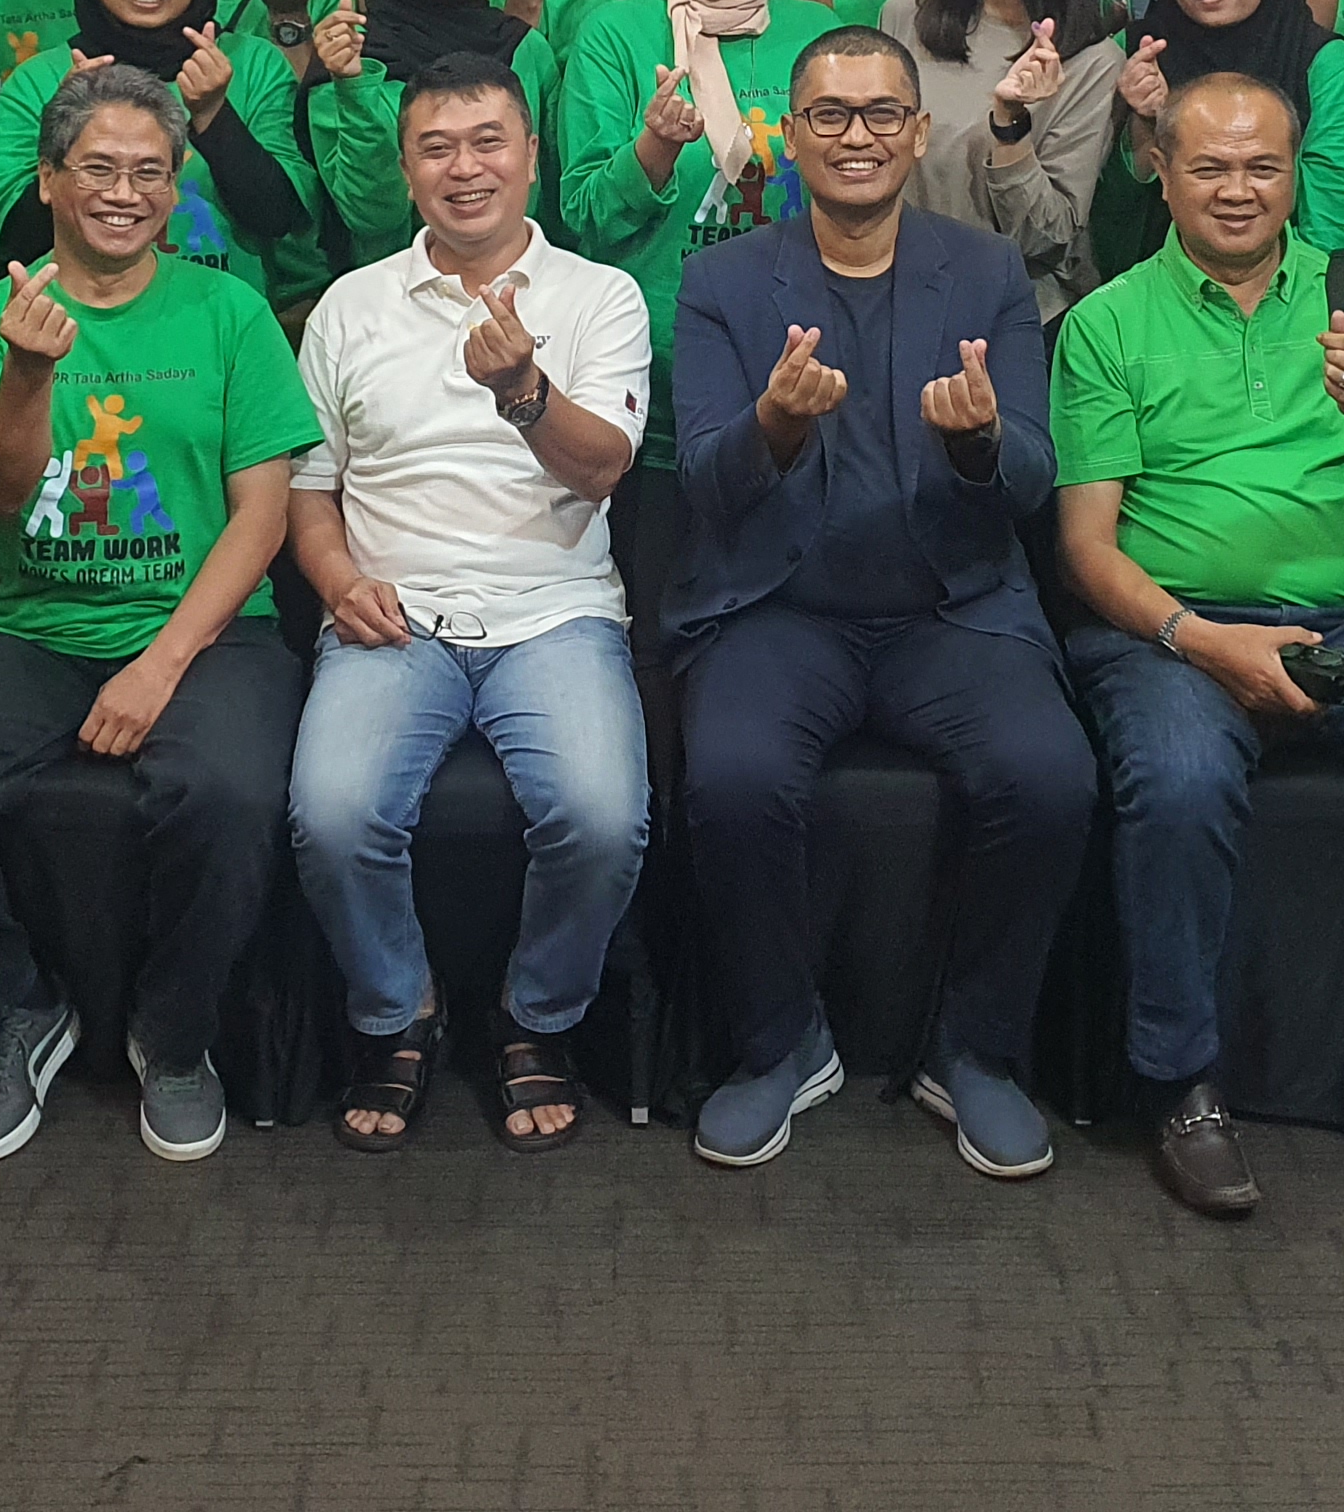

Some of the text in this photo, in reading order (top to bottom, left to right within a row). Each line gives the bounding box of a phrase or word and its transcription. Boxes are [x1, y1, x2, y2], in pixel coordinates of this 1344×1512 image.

[25, 11, 56, 23] Artha
[688, 225, 756, 245] TEA
[52, 367, 196, 385] PR Tata Artha Sadaya
[21, 533, 181, 562] TEAM WORK
[143, 559, 186, 581] TEAM
